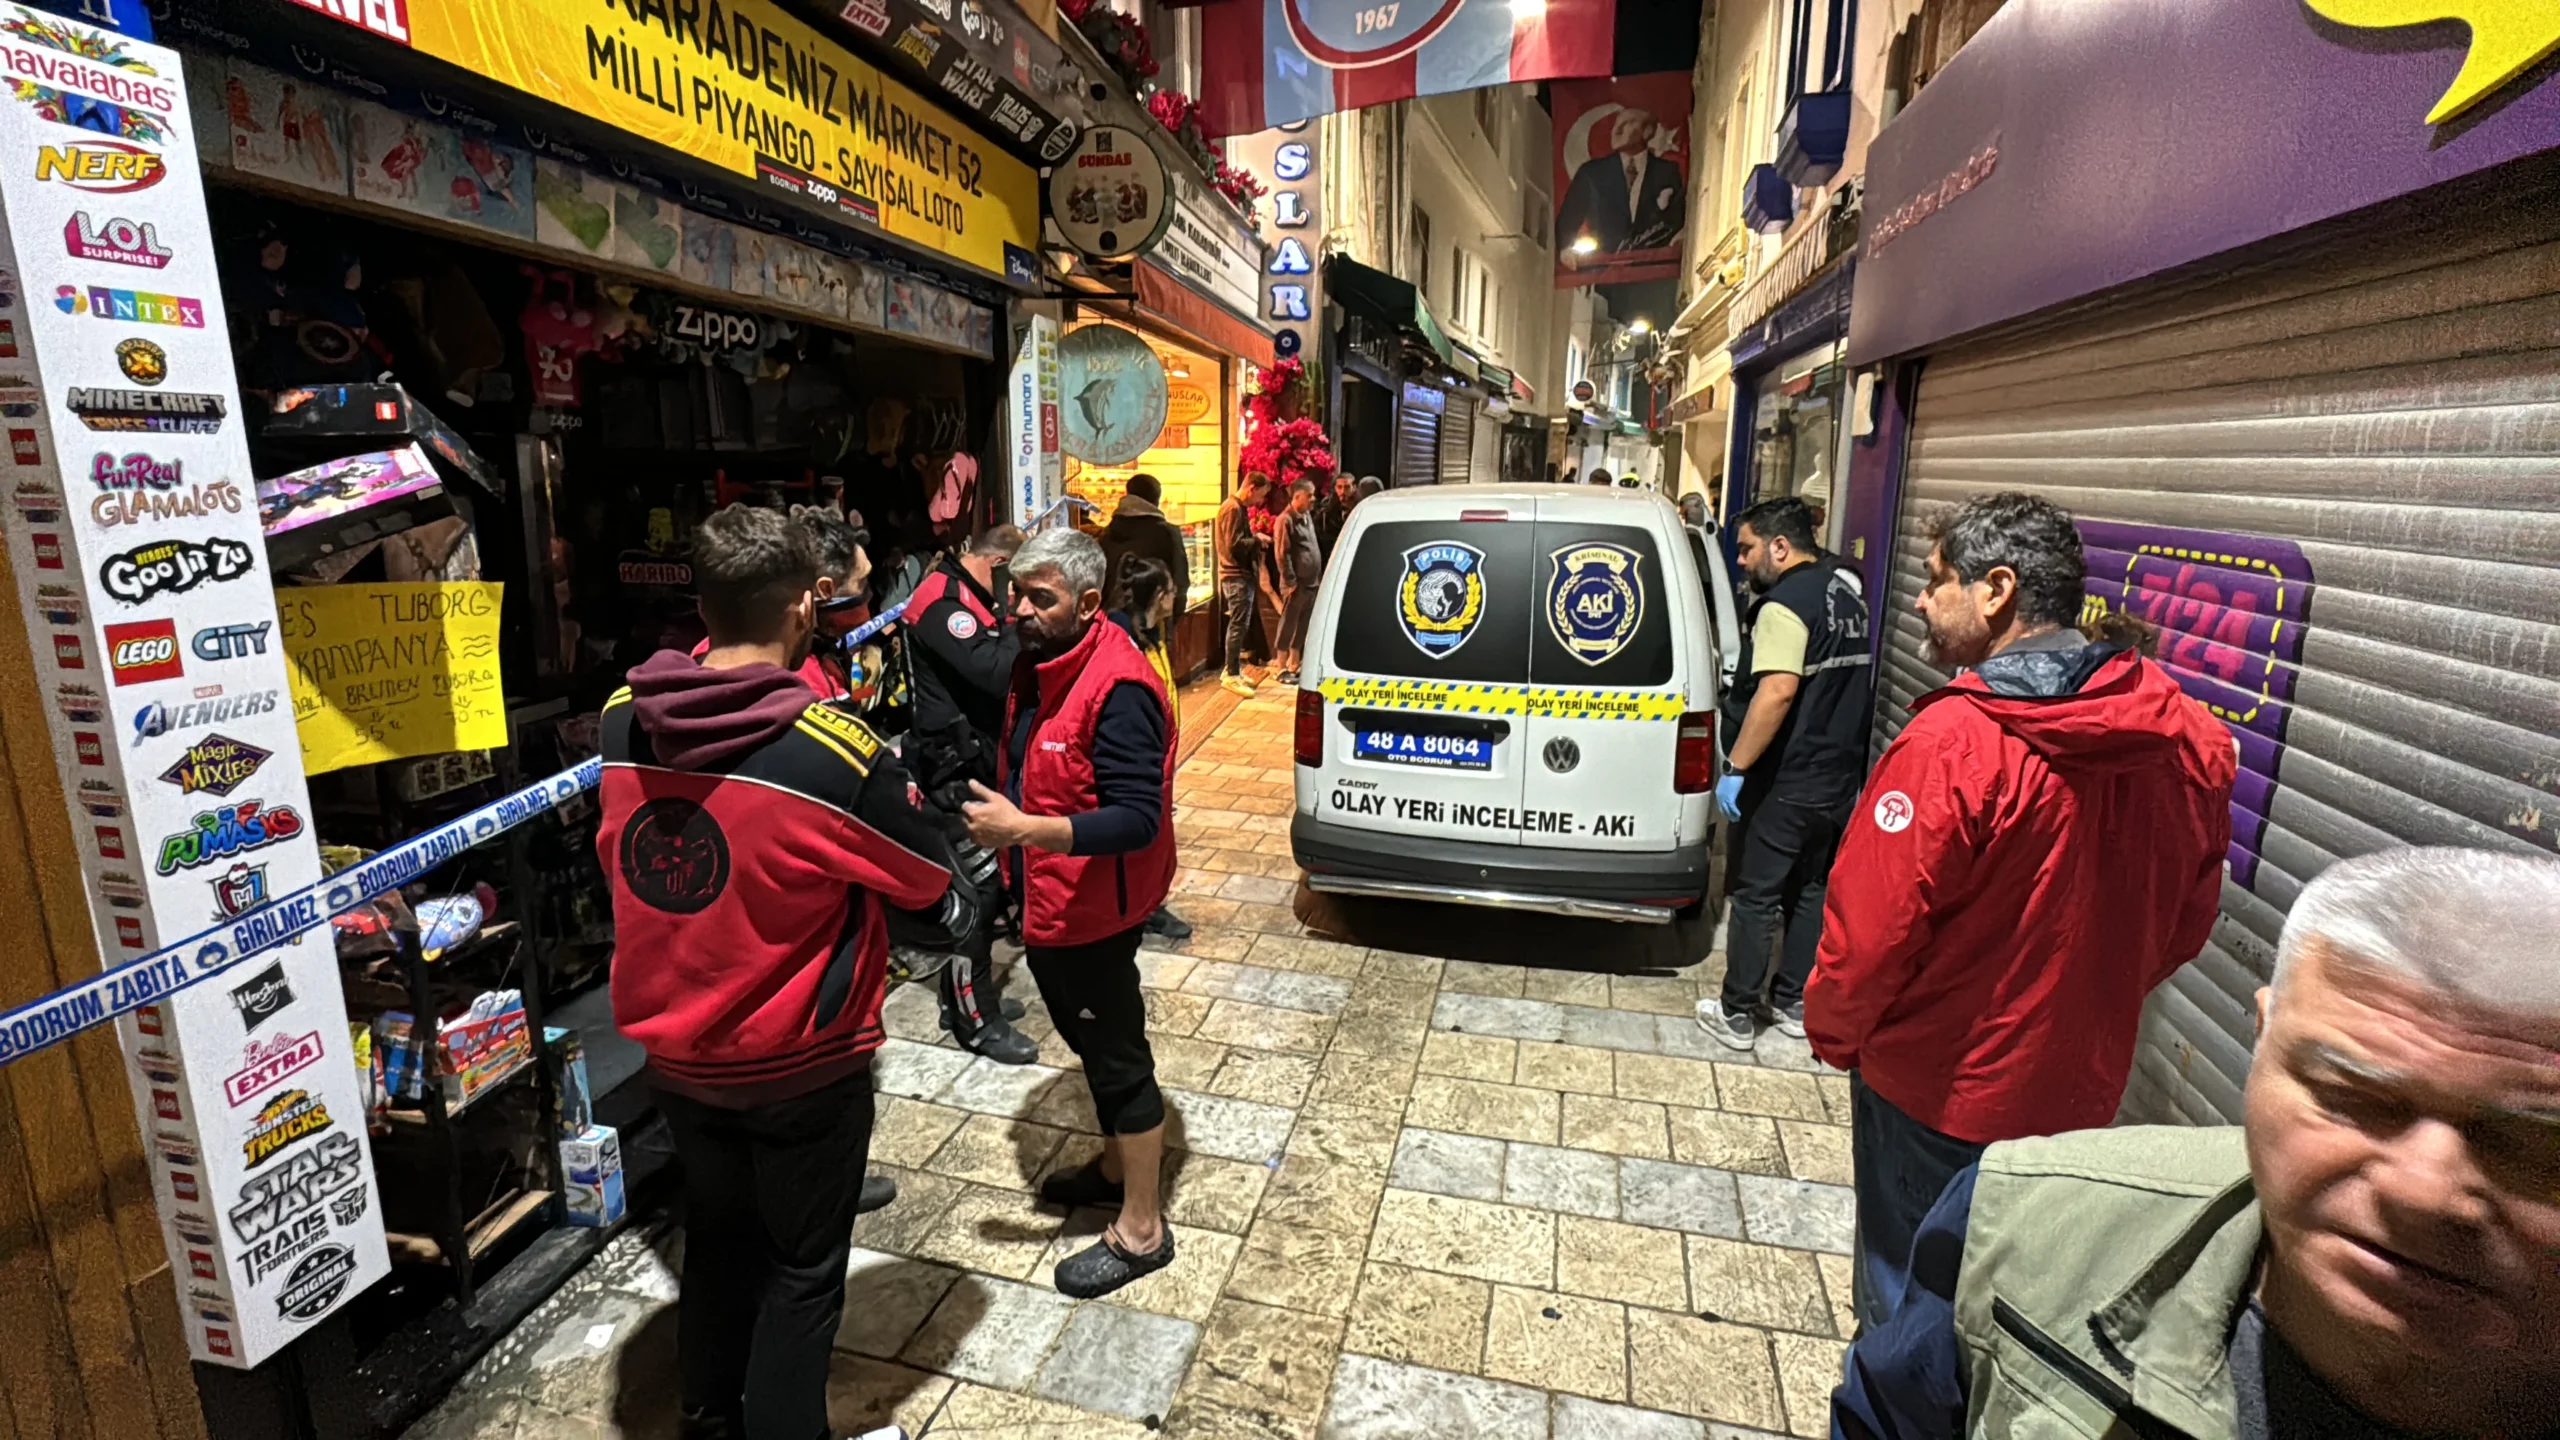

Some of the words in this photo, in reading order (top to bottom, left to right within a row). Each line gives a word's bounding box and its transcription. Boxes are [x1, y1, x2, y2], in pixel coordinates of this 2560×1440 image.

[846, 4, 885, 31] EXTRA
[1355, 3, 1399, 34] 1967
[605, 0, 841, 125] ARADENİZ
[848, 79, 952, 181] MARKET
[958, 145, 983, 199] 52
[586, 24, 685, 117] MİLLİ
[693, 74, 815, 172] PİYANGO
[838, 148, 920, 218] SAYISAL
[923, 187, 964, 236] LOTO
[36, 146, 162, 181] NERF
[770, 174, 799, 194] BODRUM
[75, 211, 172, 257] LOL
[83, 246, 158, 267] SURPRISE!
[91, 292, 202, 326] INTEX
[67, 387, 227, 418] MINECRAFT
[1022, 373, 1033, 431] numara
[157, 417, 222, 434] CLIFFS
[1022, 433, 1033, 456] on
[135, 546, 174, 565] HEROES
[619, 562, 692, 584] HARIBO
[1576, 590, 1613, 612] AKİ
[114, 636, 176, 667] LEGO
[296, 630, 455, 687] KAMPANYA
[1345, 688, 1368, 698] OLAY
[1371, 688, 1394, 700] YERİ
[1397, 690, 1447, 703] İNCELEME
[1527, 698, 1554, 710] OLAY
[1557, 698, 1583, 711] YERİ
[1585, 697, 1639, 712] İNCELEME
[133, 690, 279, 748] AVENGERS
[190, 741, 240, 762] Magic
[1367, 731, 1394, 750] 48
[1400, 734, 1416, 752] A
[1423, 735, 1479, 757] 8064
[1387, 754, 1407, 762] OTO
[1410, 755, 1453, 766] BODRUM
[1338, 778, 1378, 790] CADDY
[1331, 789, 1386, 816] OLAY
[160, 838, 201, 873] PJ
[200, 806, 303, 860] MASKS
[0, 989, 106, 1058] BODRUM
[107, 955, 189, 1007] ZABITA
[233, 895, 320, 956] GİRİLMEZ
[357, 850, 421, 897] BODRUM
[421, 824, 471, 868] ZABITA
[237, 977, 290, 1010] Hasbro
[244, 1032, 296, 1068] Barbie
[237, 1043, 313, 1096] EXTRA
[243, 1092, 323, 1141] MONSTER
[243, 1104, 331, 1167] TRUCKS
[241, 1131, 360, 1206] STAR
[229, 1151, 362, 1245] WARS
[237, 1206, 328, 1288] TRANS
[257, 1226, 329, 1278] FORMERS
[284, 1258, 350, 1307] ORIGINAL
